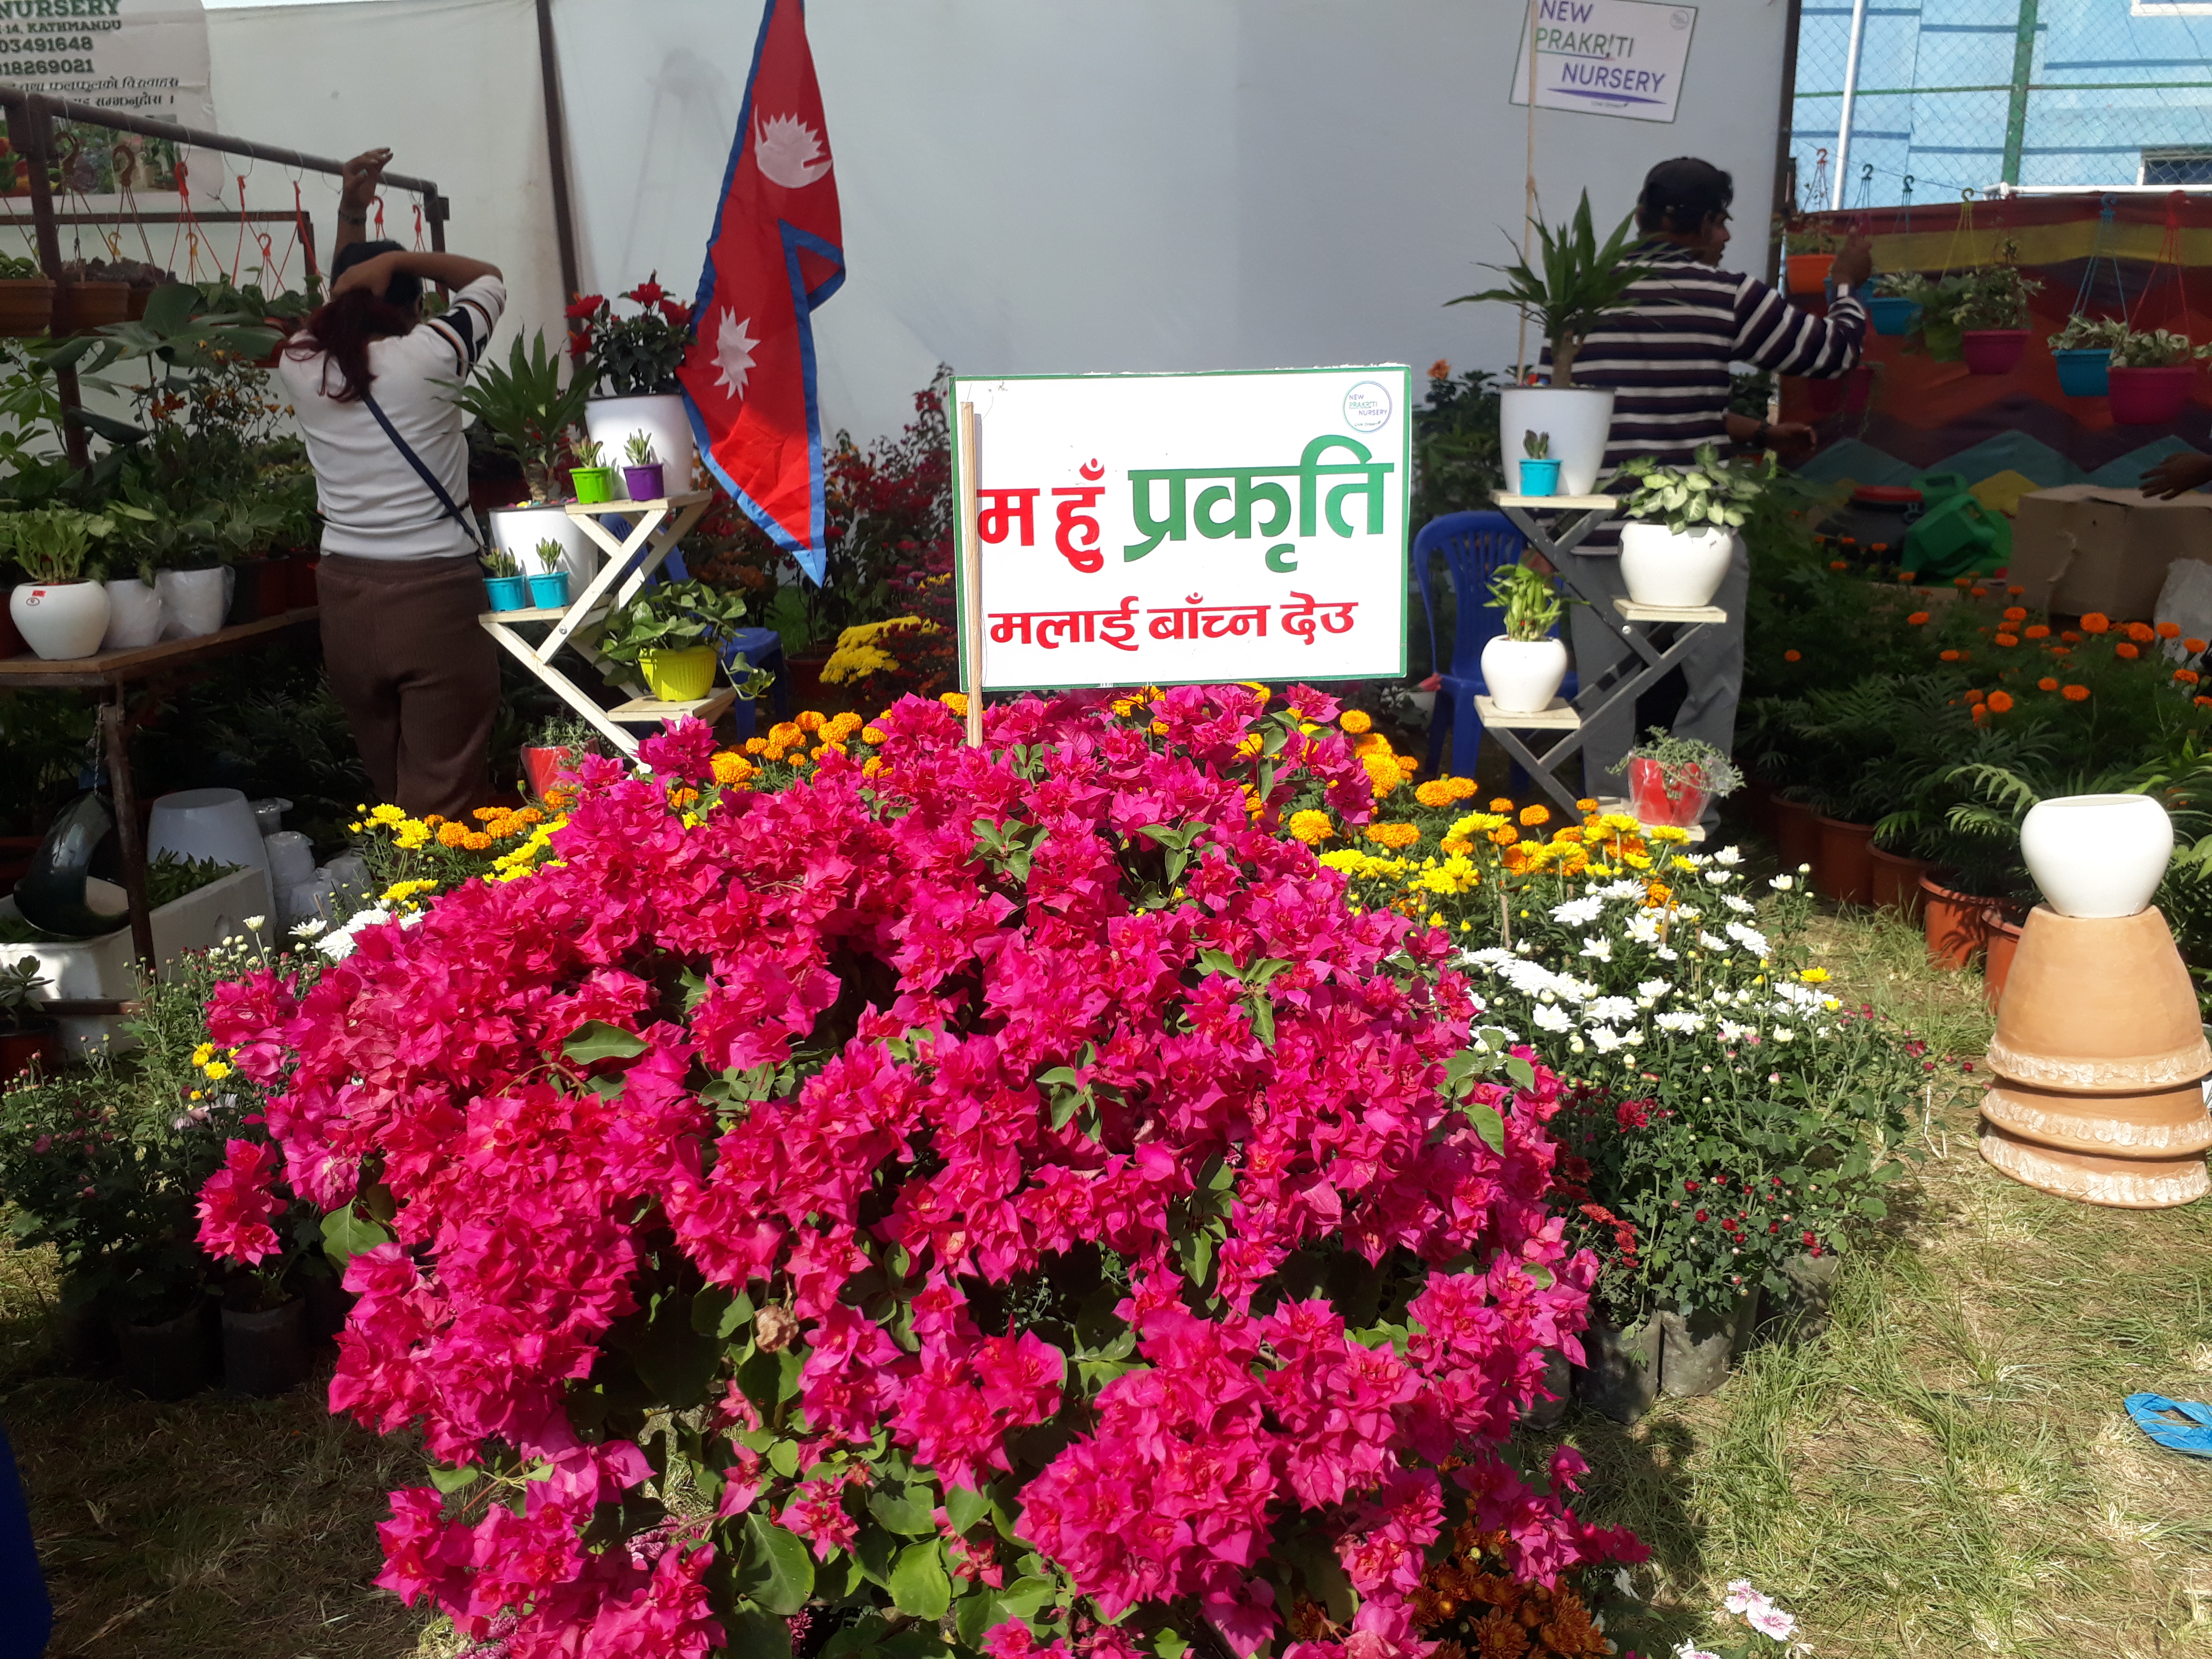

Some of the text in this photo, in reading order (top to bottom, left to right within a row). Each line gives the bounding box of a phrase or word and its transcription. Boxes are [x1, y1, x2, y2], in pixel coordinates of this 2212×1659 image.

[0, 0, 119, 19] NURSERY
[1540, 0, 1593, 23] NEW
[27, 20, 122, 33] KATHMANDU
[0, 36, 93, 53] 03491648
[1536, 27, 1634, 58] PRAKRITI
[0, 58, 94, 75] 18269021
[1562, 62, 1665, 93] NURSERY
[976, 487, 1041, 547] म
[1123, 434, 1395, 573] प्रकृति
[987, 591, 1359, 652] मलाई बाँच्न देउ
